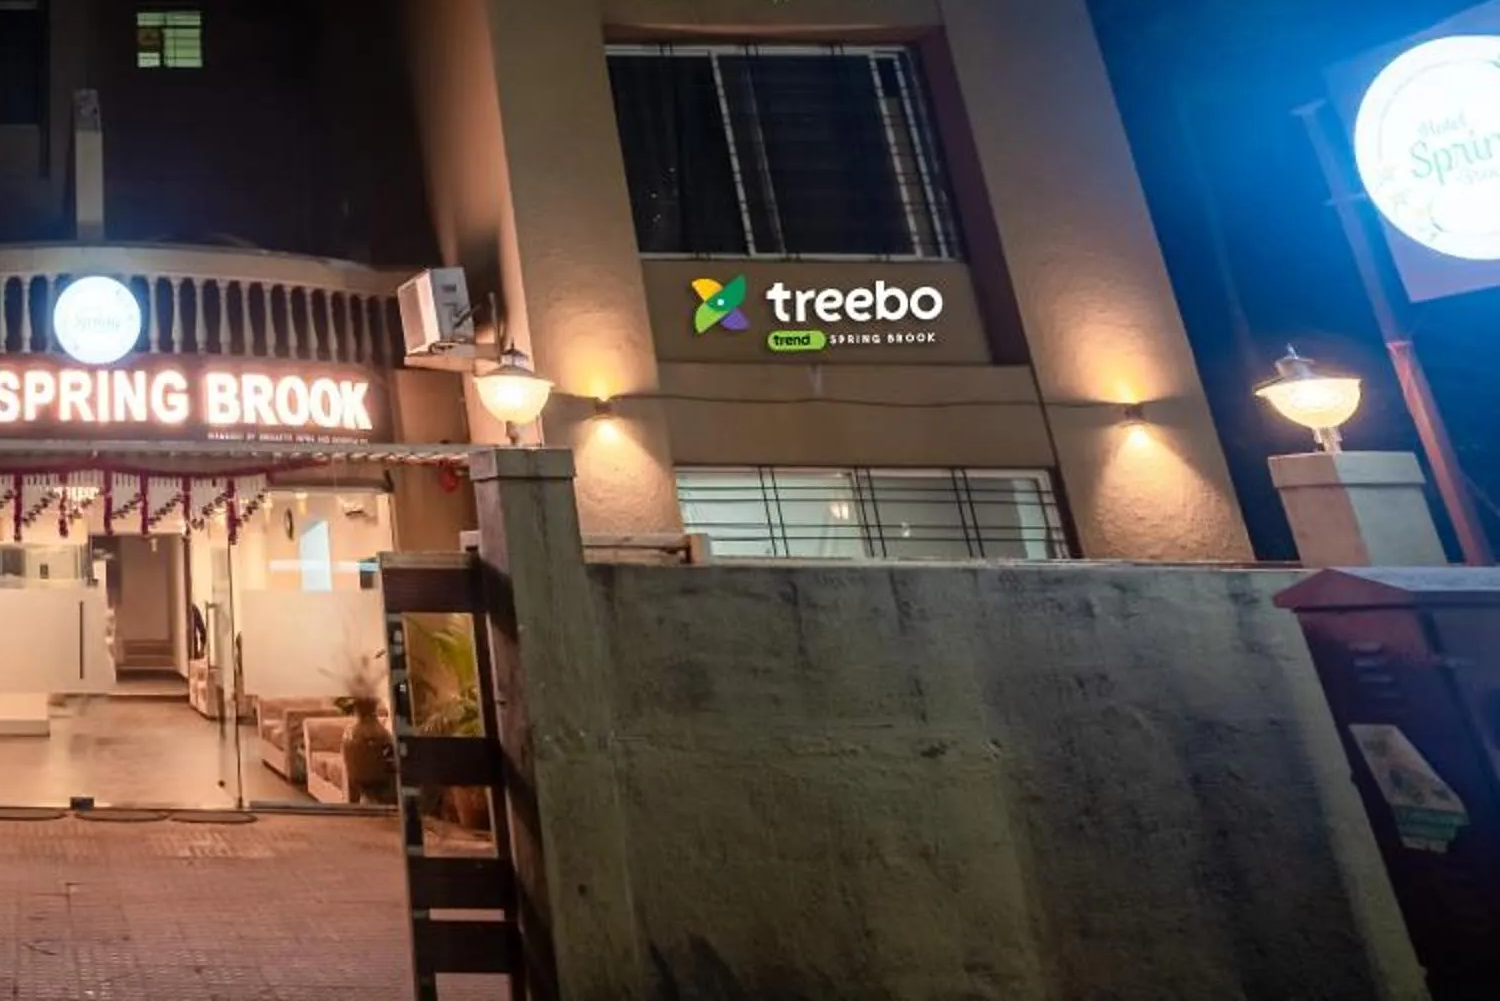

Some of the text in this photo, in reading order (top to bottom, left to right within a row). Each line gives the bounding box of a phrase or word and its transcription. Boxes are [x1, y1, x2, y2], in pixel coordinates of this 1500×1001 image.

[766, 280, 943, 322] treebo
[773, 333, 811, 347] trend
[829, 331, 936, 345] SPRING BROOK
[205, 372, 373, 430] BROOK
